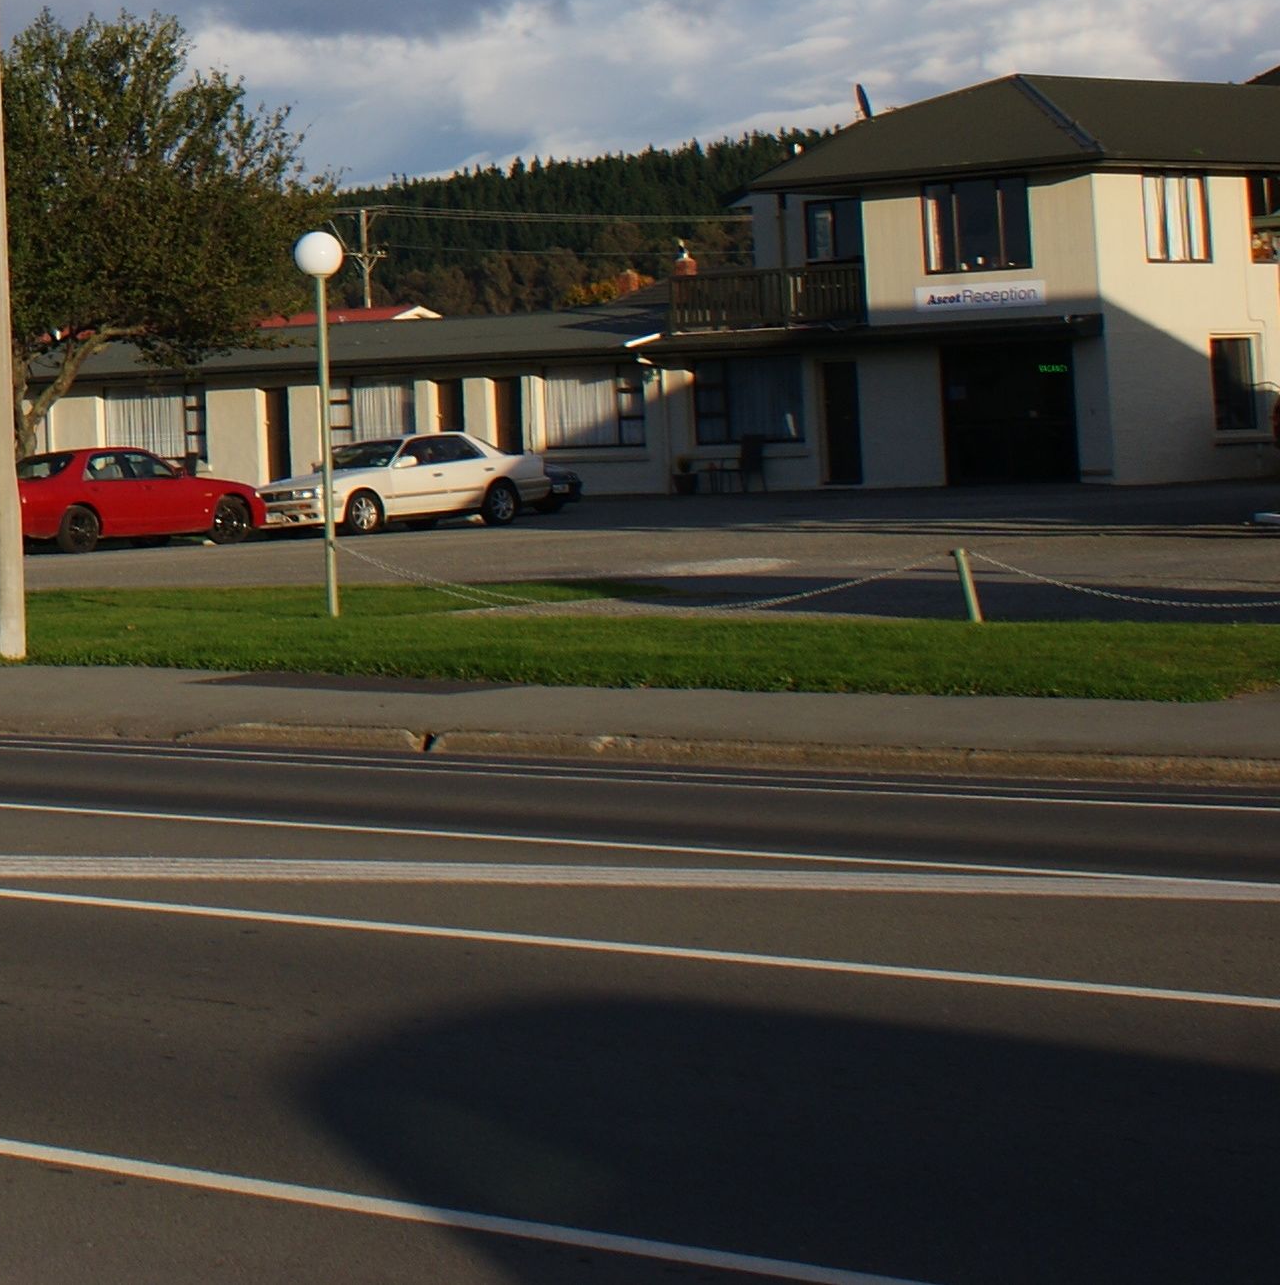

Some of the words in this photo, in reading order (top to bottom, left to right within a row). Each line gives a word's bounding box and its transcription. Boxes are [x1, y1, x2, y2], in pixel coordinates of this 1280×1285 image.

[926, 293, 961, 305] Ascot
[962, 288, 1038, 303] Reception
[1039, 364, 1068, 373] VACANCY
